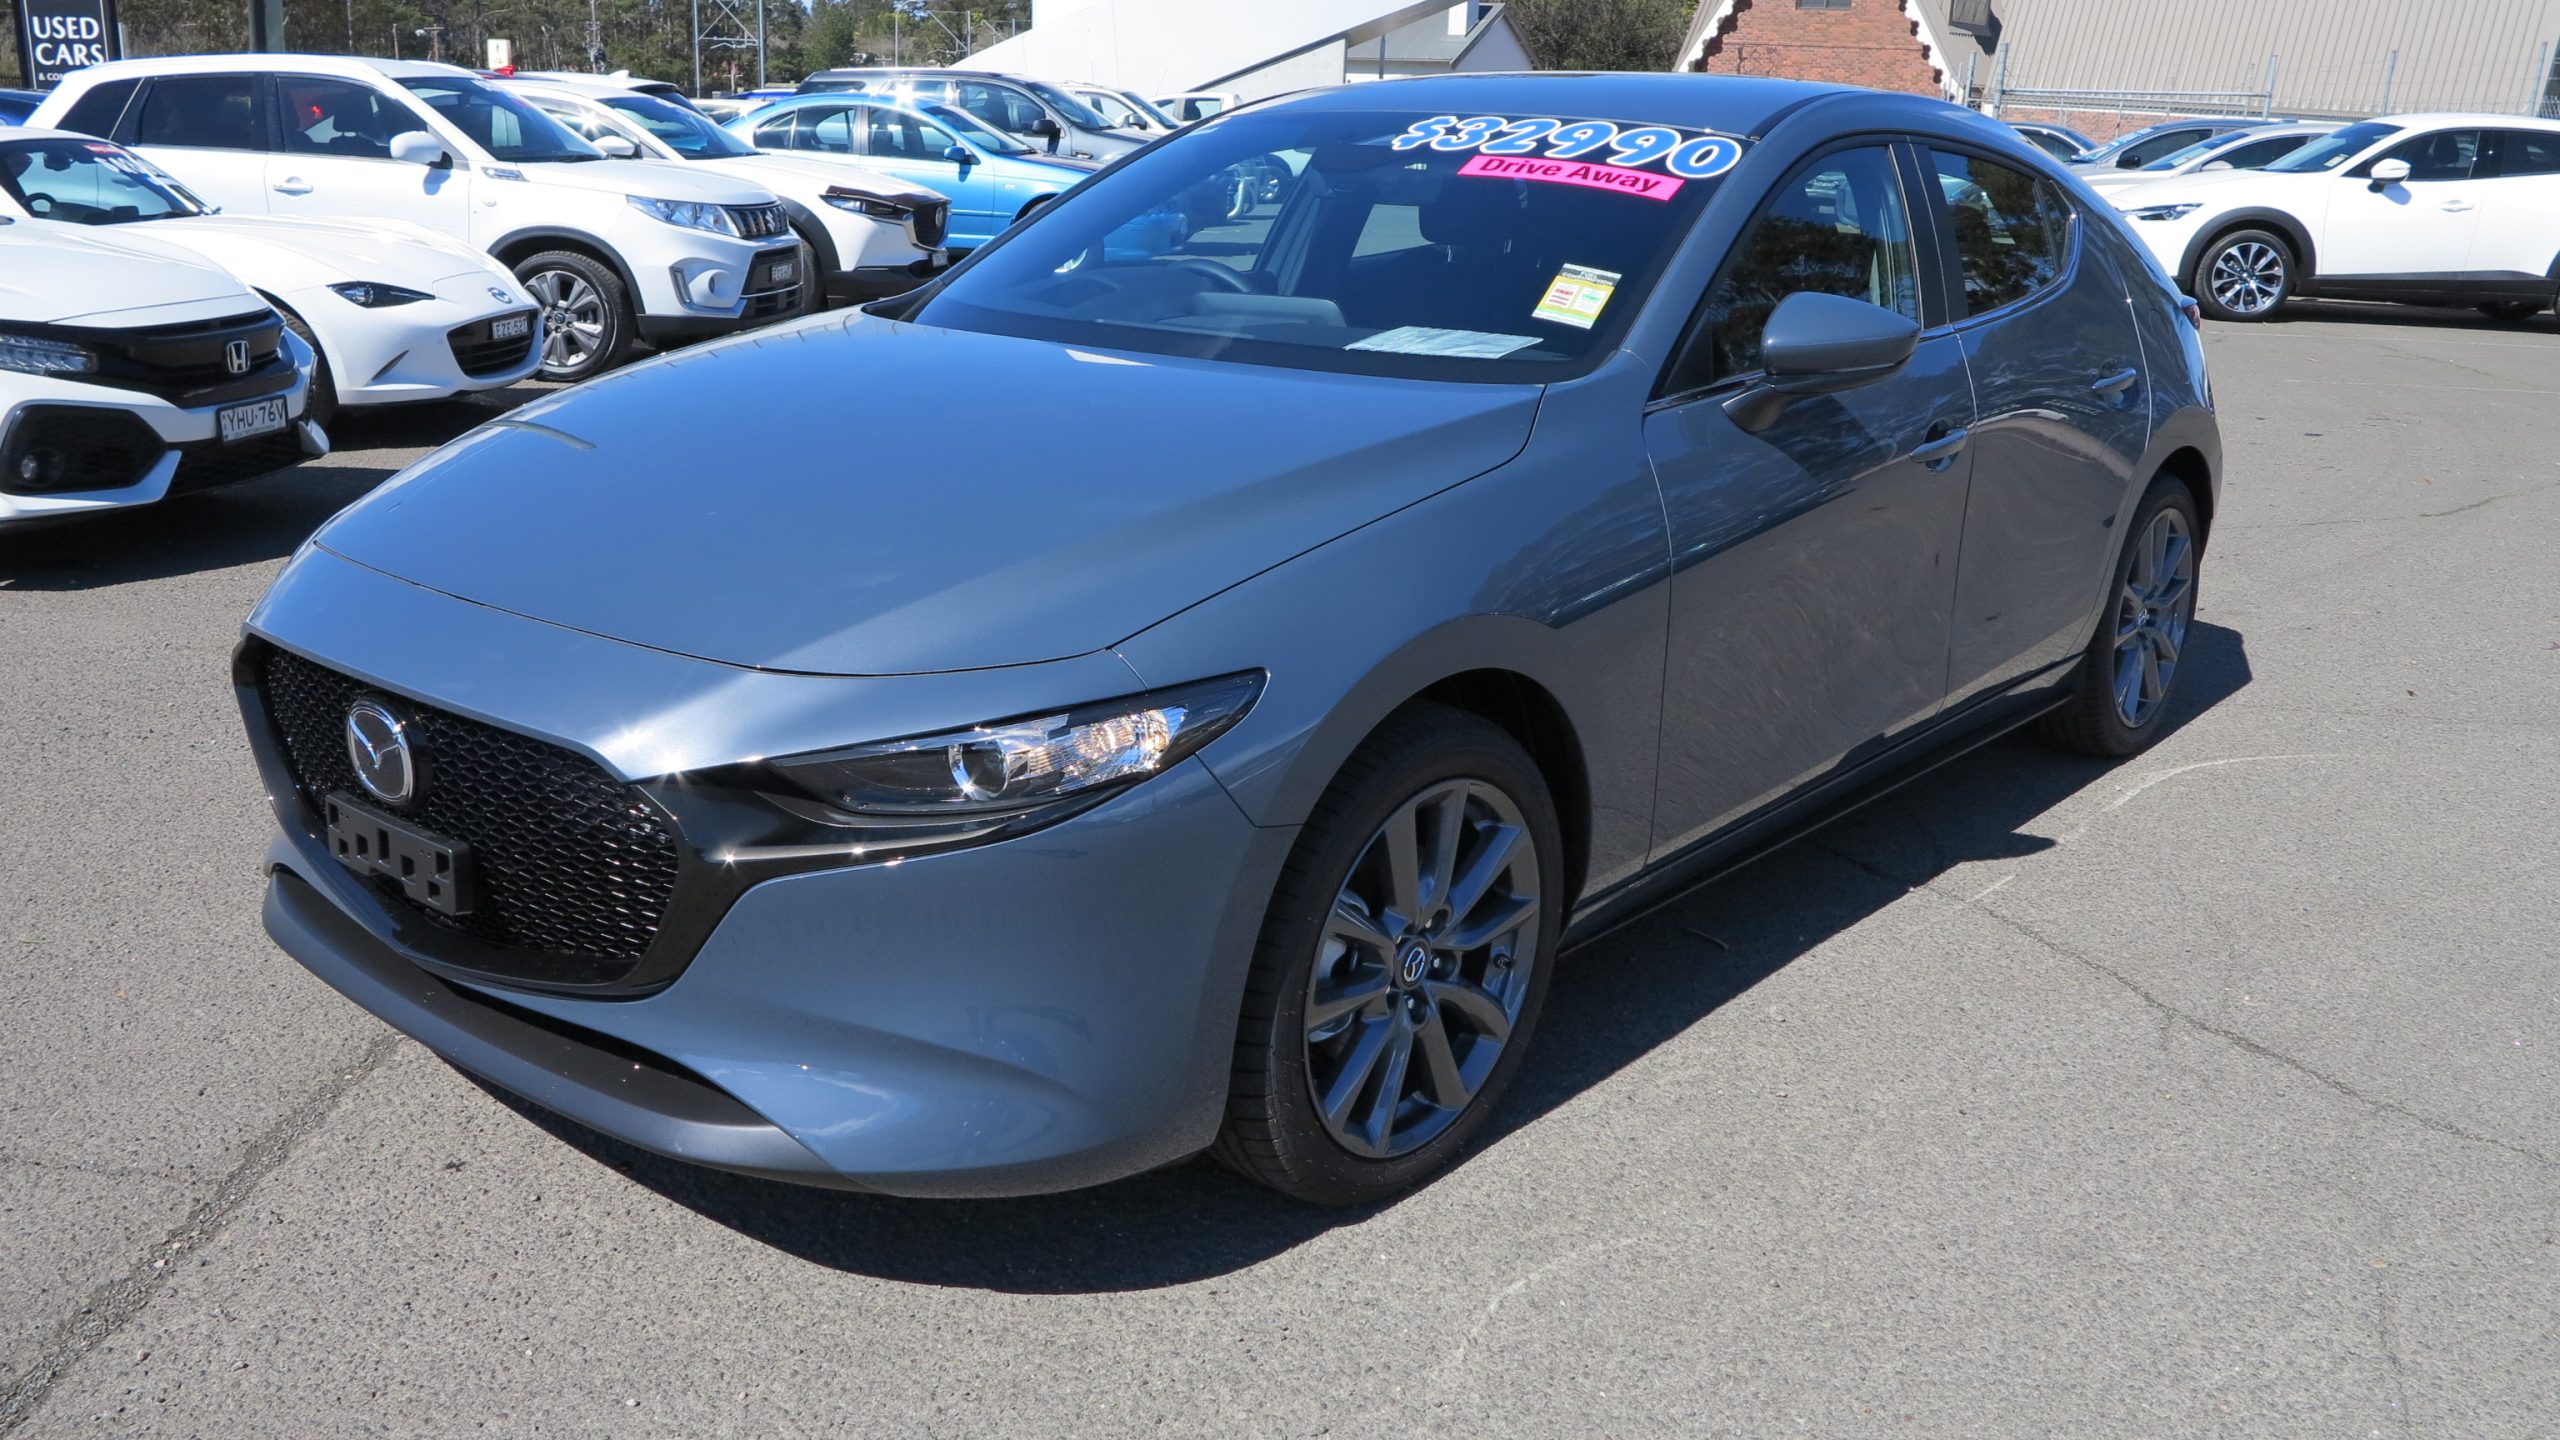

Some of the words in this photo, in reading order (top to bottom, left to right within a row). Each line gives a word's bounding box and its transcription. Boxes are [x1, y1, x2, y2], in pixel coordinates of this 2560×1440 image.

[32, 16, 100, 39] USED
[35, 42, 104, 66] CARS
[1391, 115, 1742, 179] $32990
[1478, 157, 1560, 177] Drive
[1567, 164, 1662, 193] Away
